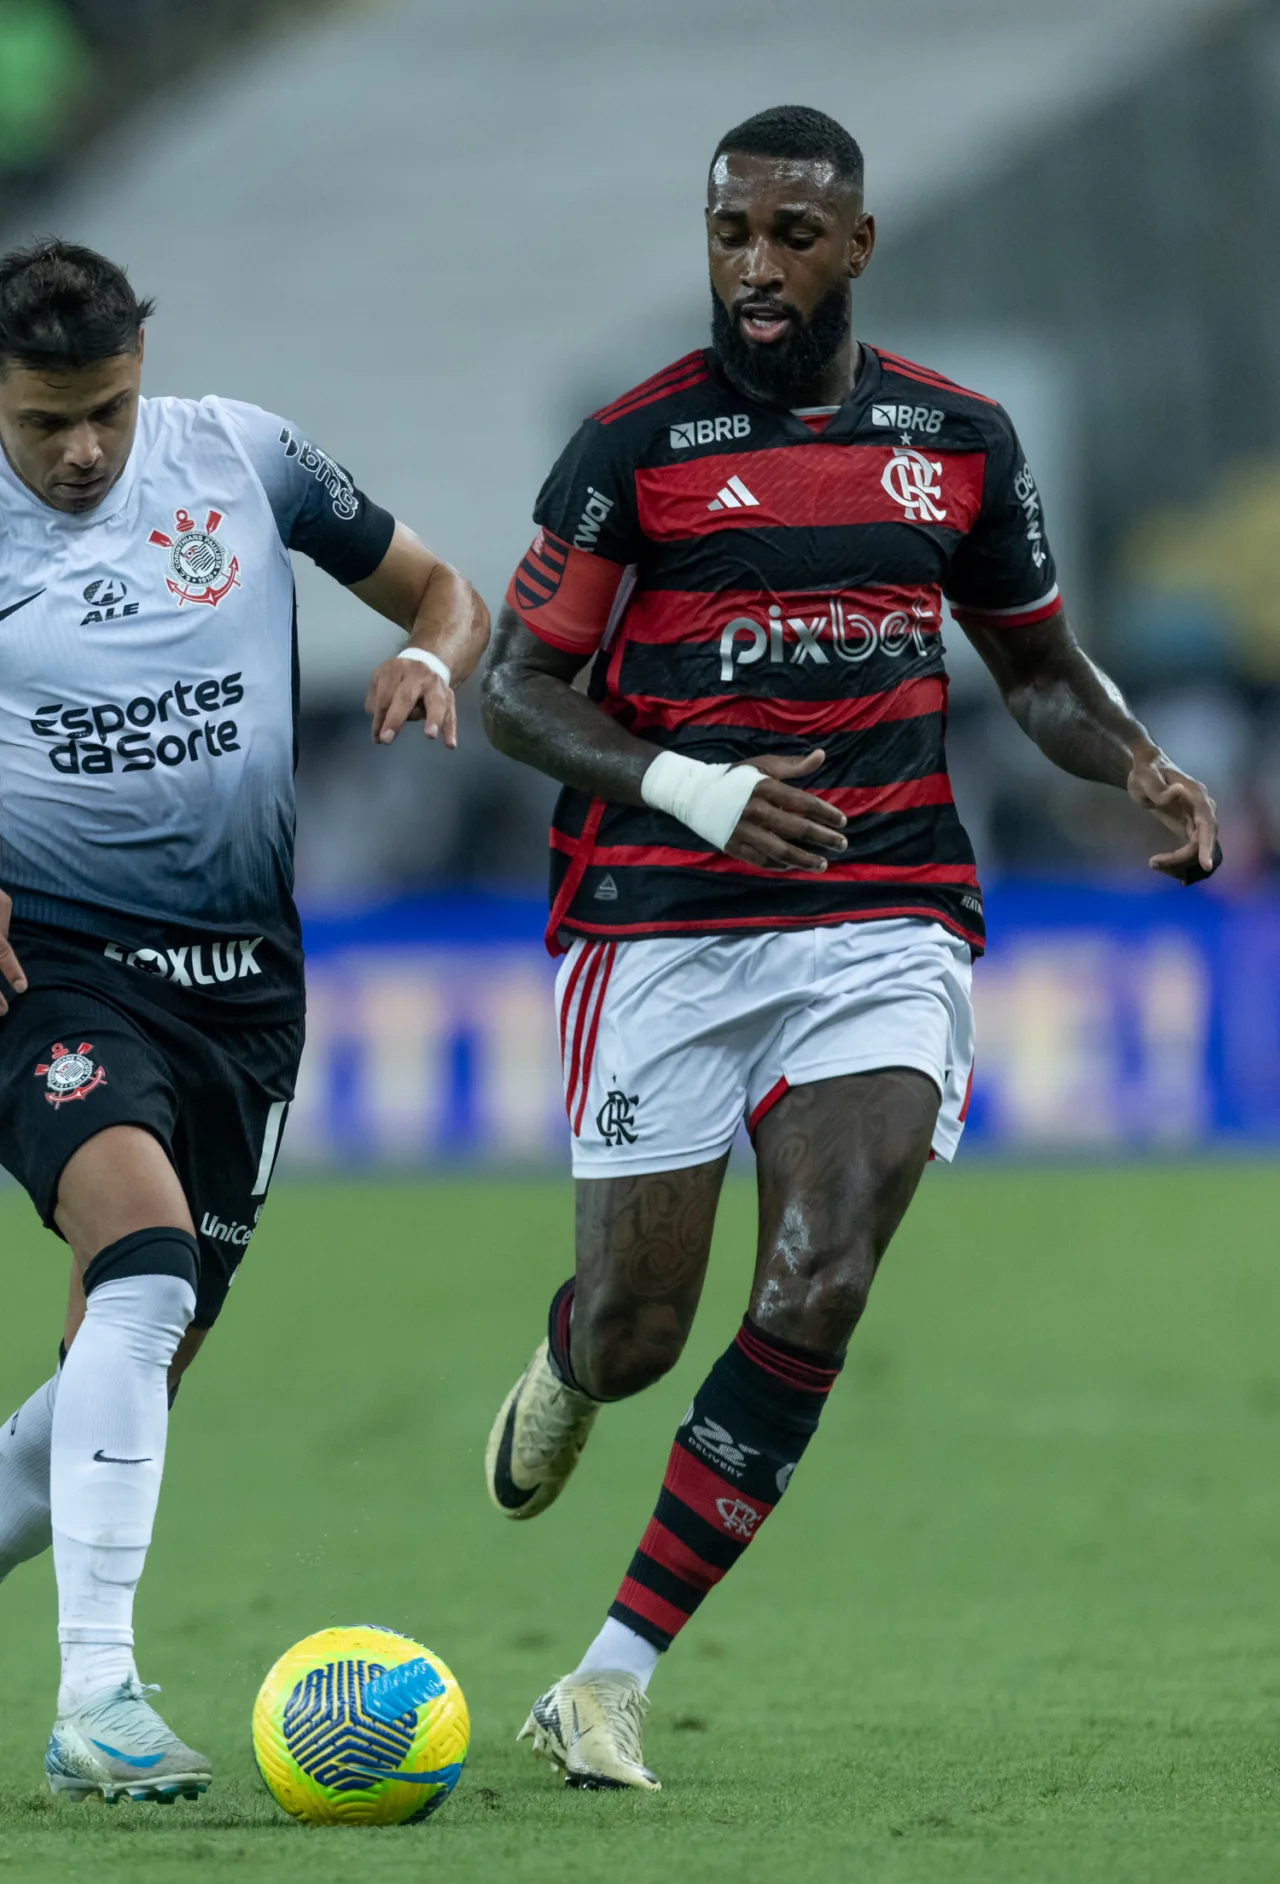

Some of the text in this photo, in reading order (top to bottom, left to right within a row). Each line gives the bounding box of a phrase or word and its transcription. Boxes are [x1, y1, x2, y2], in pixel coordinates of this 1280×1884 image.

[696, 413, 751, 445] BRB
[896, 404, 946, 434] BRB
[297, 439, 360, 520] bmg
[79, 602, 140, 626] ALE
[720, 598, 934, 682] pixbet
[29, 671, 245, 745] Esportes
[199, 1211, 254, 1246] UniCe
[687, 1436, 744, 1479] DELIVERY
